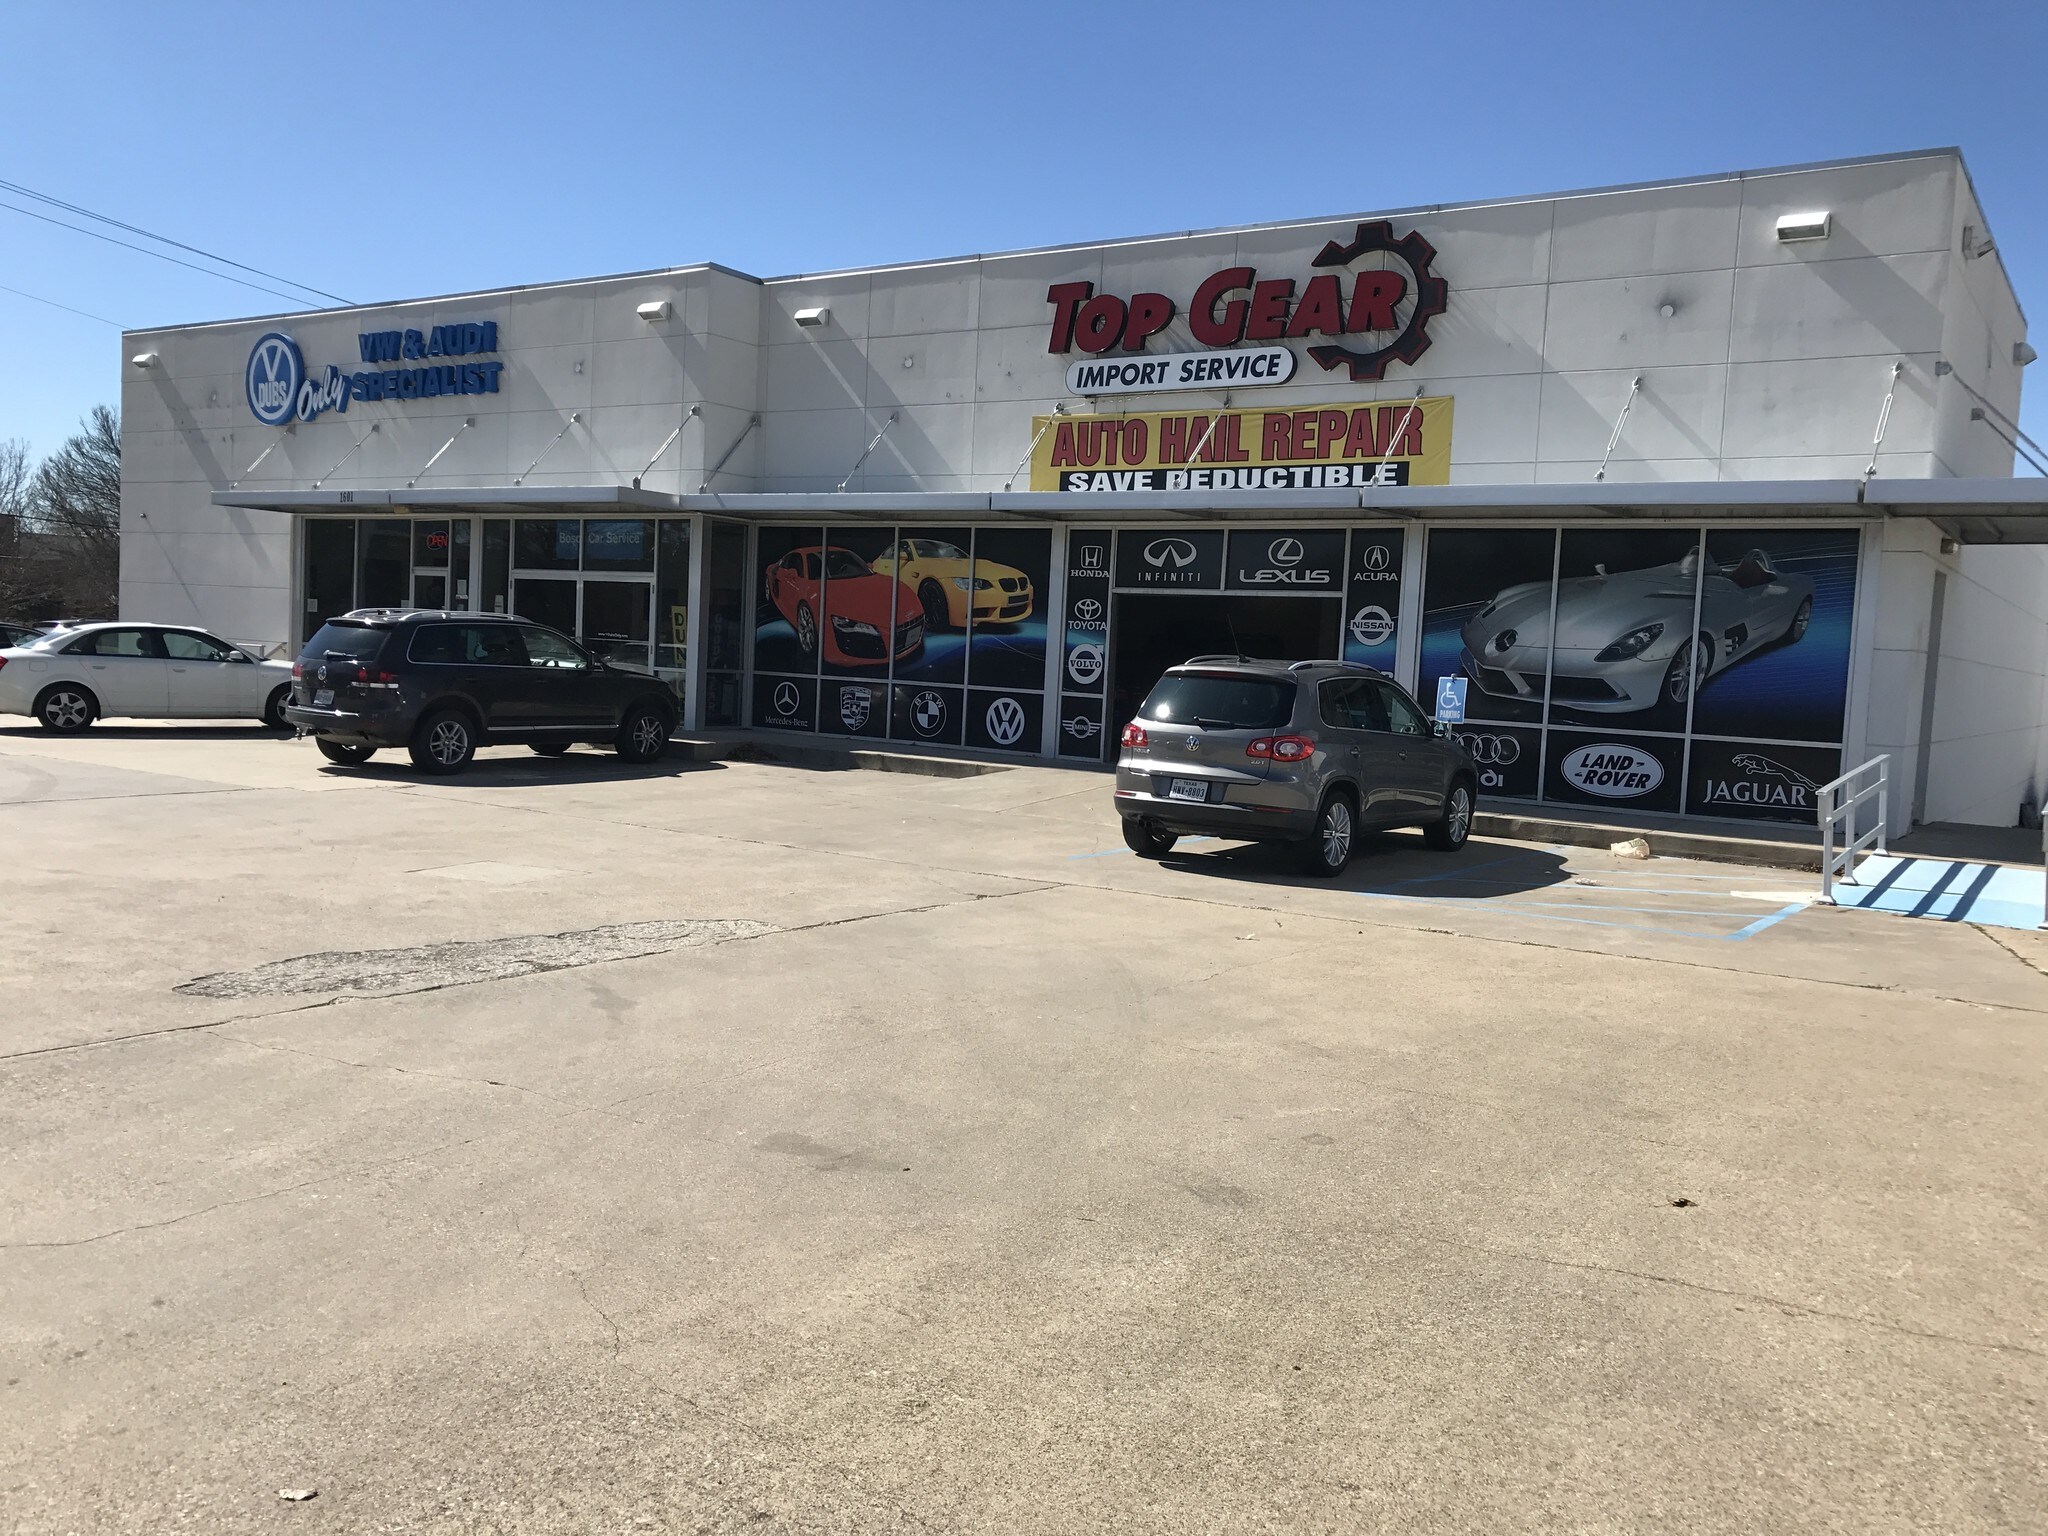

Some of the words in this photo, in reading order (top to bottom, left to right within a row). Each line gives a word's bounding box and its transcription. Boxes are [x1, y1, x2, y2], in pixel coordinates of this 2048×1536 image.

[1047, 281, 1175, 354] TOP
[1189, 266, 1407, 347] GEAR
[358, 331, 402, 363] VW
[402, 329, 426, 360] &
[426, 321, 498, 356] AUDI
[1076, 362, 1170, 388] IMPORT
[1179, 353, 1282, 382] SERVICE
[351, 362, 504, 402] SPECIALIST
[258, 381, 287, 407] DUBS
[297, 365, 351, 422] Only
[1050, 418, 1148, 467] AUTO
[1159, 414, 1249, 464] HAIL
[1261, 405, 1423, 461] REPAIR
[1068, 470, 1153, 492] SAVE
[1166, 463, 1398, 490] DEDUCTIBLE
[340, 491, 353, 502] 1601
[427, 534, 448, 547] OPEN
[559, 532, 580, 544] Bosc
[588, 532, 603, 544] Car
[606, 531, 640, 544] Service
[1070, 569, 1110, 578] HONDA
[1138, 572, 1201, 582] INFINITI
[1239, 569, 1331, 584] LEXUS
[1353, 572, 1399, 582] ACURA
[1068, 620, 1108, 631] TOYOTA
[1352, 621, 1393, 630] NISSAN
[1070, 659, 1102, 668] VOLVO
[914, 692, 944, 709] BMW
[1439, 709, 1461, 719] PARKING
[765, 715, 809, 728] Mercedes-Benz
[1074, 723, 1088, 732] MINI
[1703, 780, 1807, 806] JAGUAR
